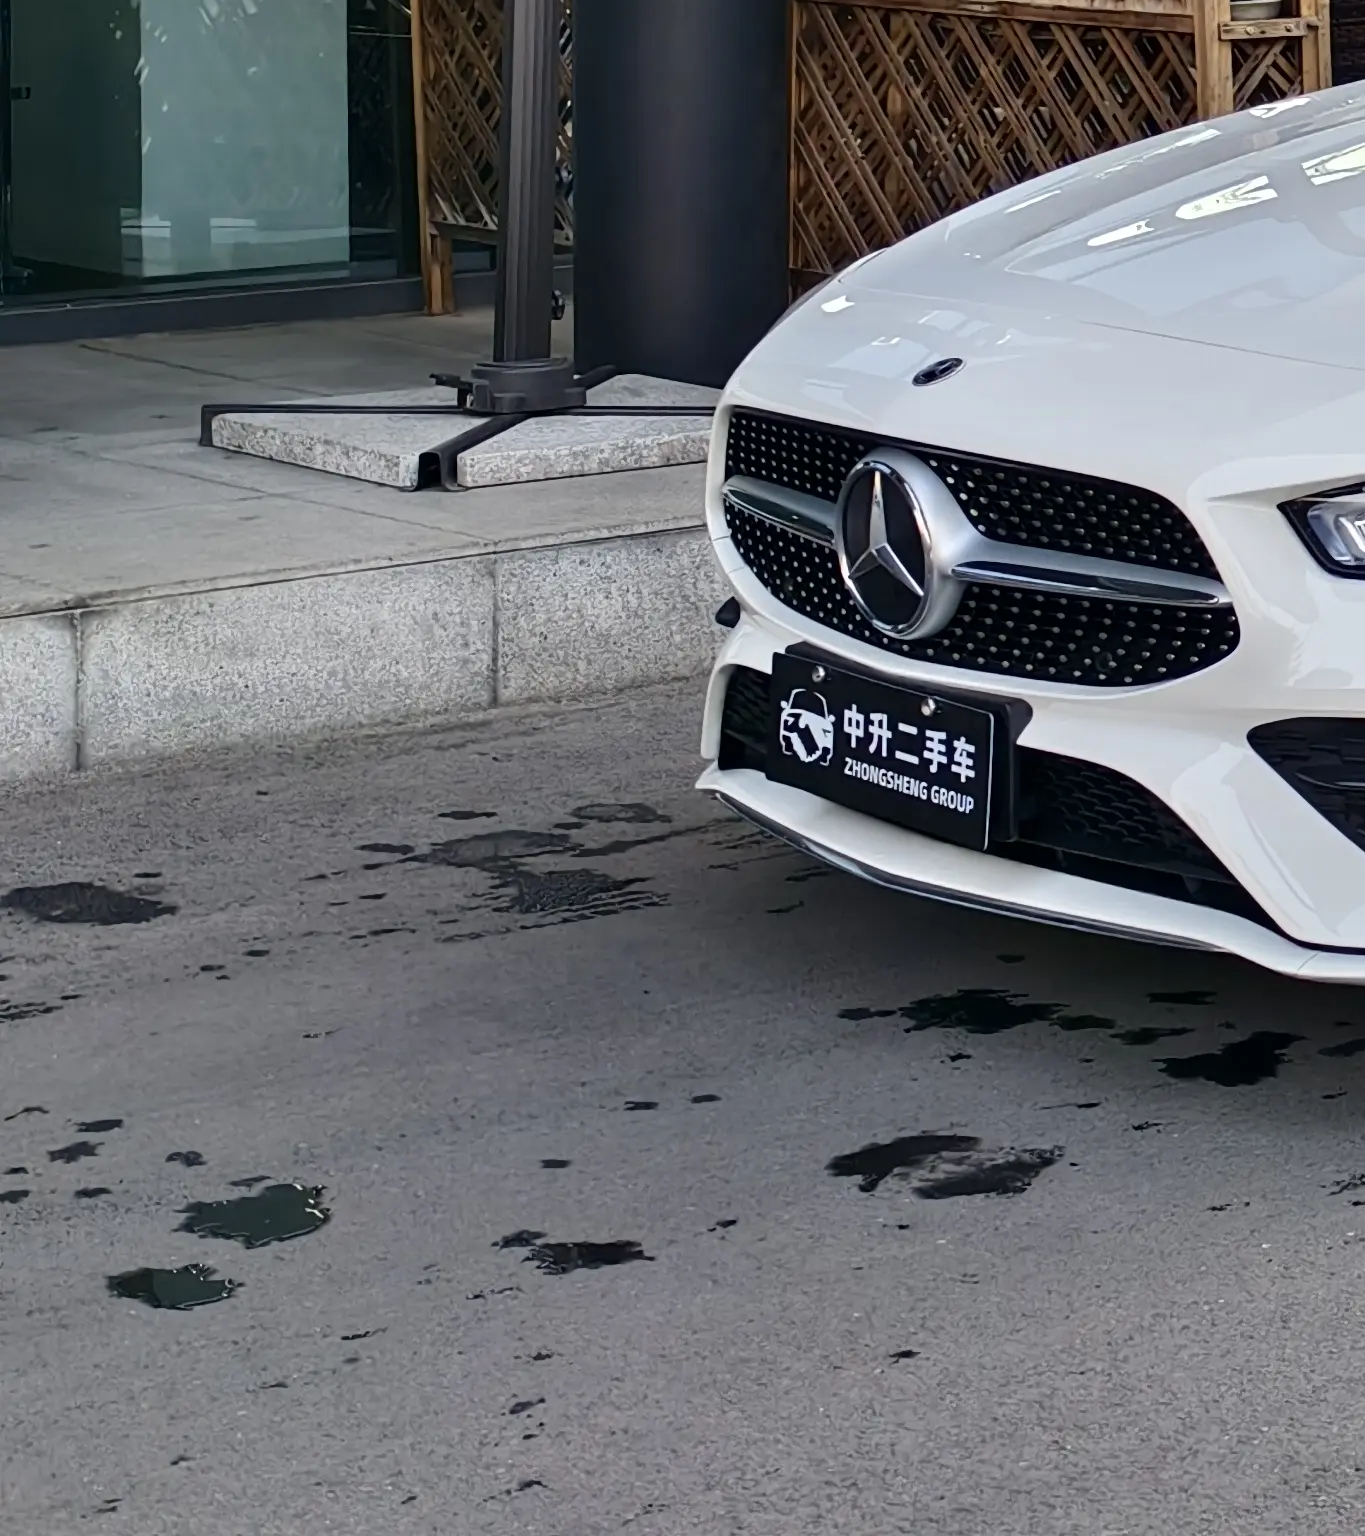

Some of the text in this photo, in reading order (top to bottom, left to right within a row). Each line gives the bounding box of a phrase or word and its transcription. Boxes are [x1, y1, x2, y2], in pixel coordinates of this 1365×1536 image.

[843, 704, 976, 783] 中升二手车
[844, 757, 975, 814] ZHONGSHENG GROUP
